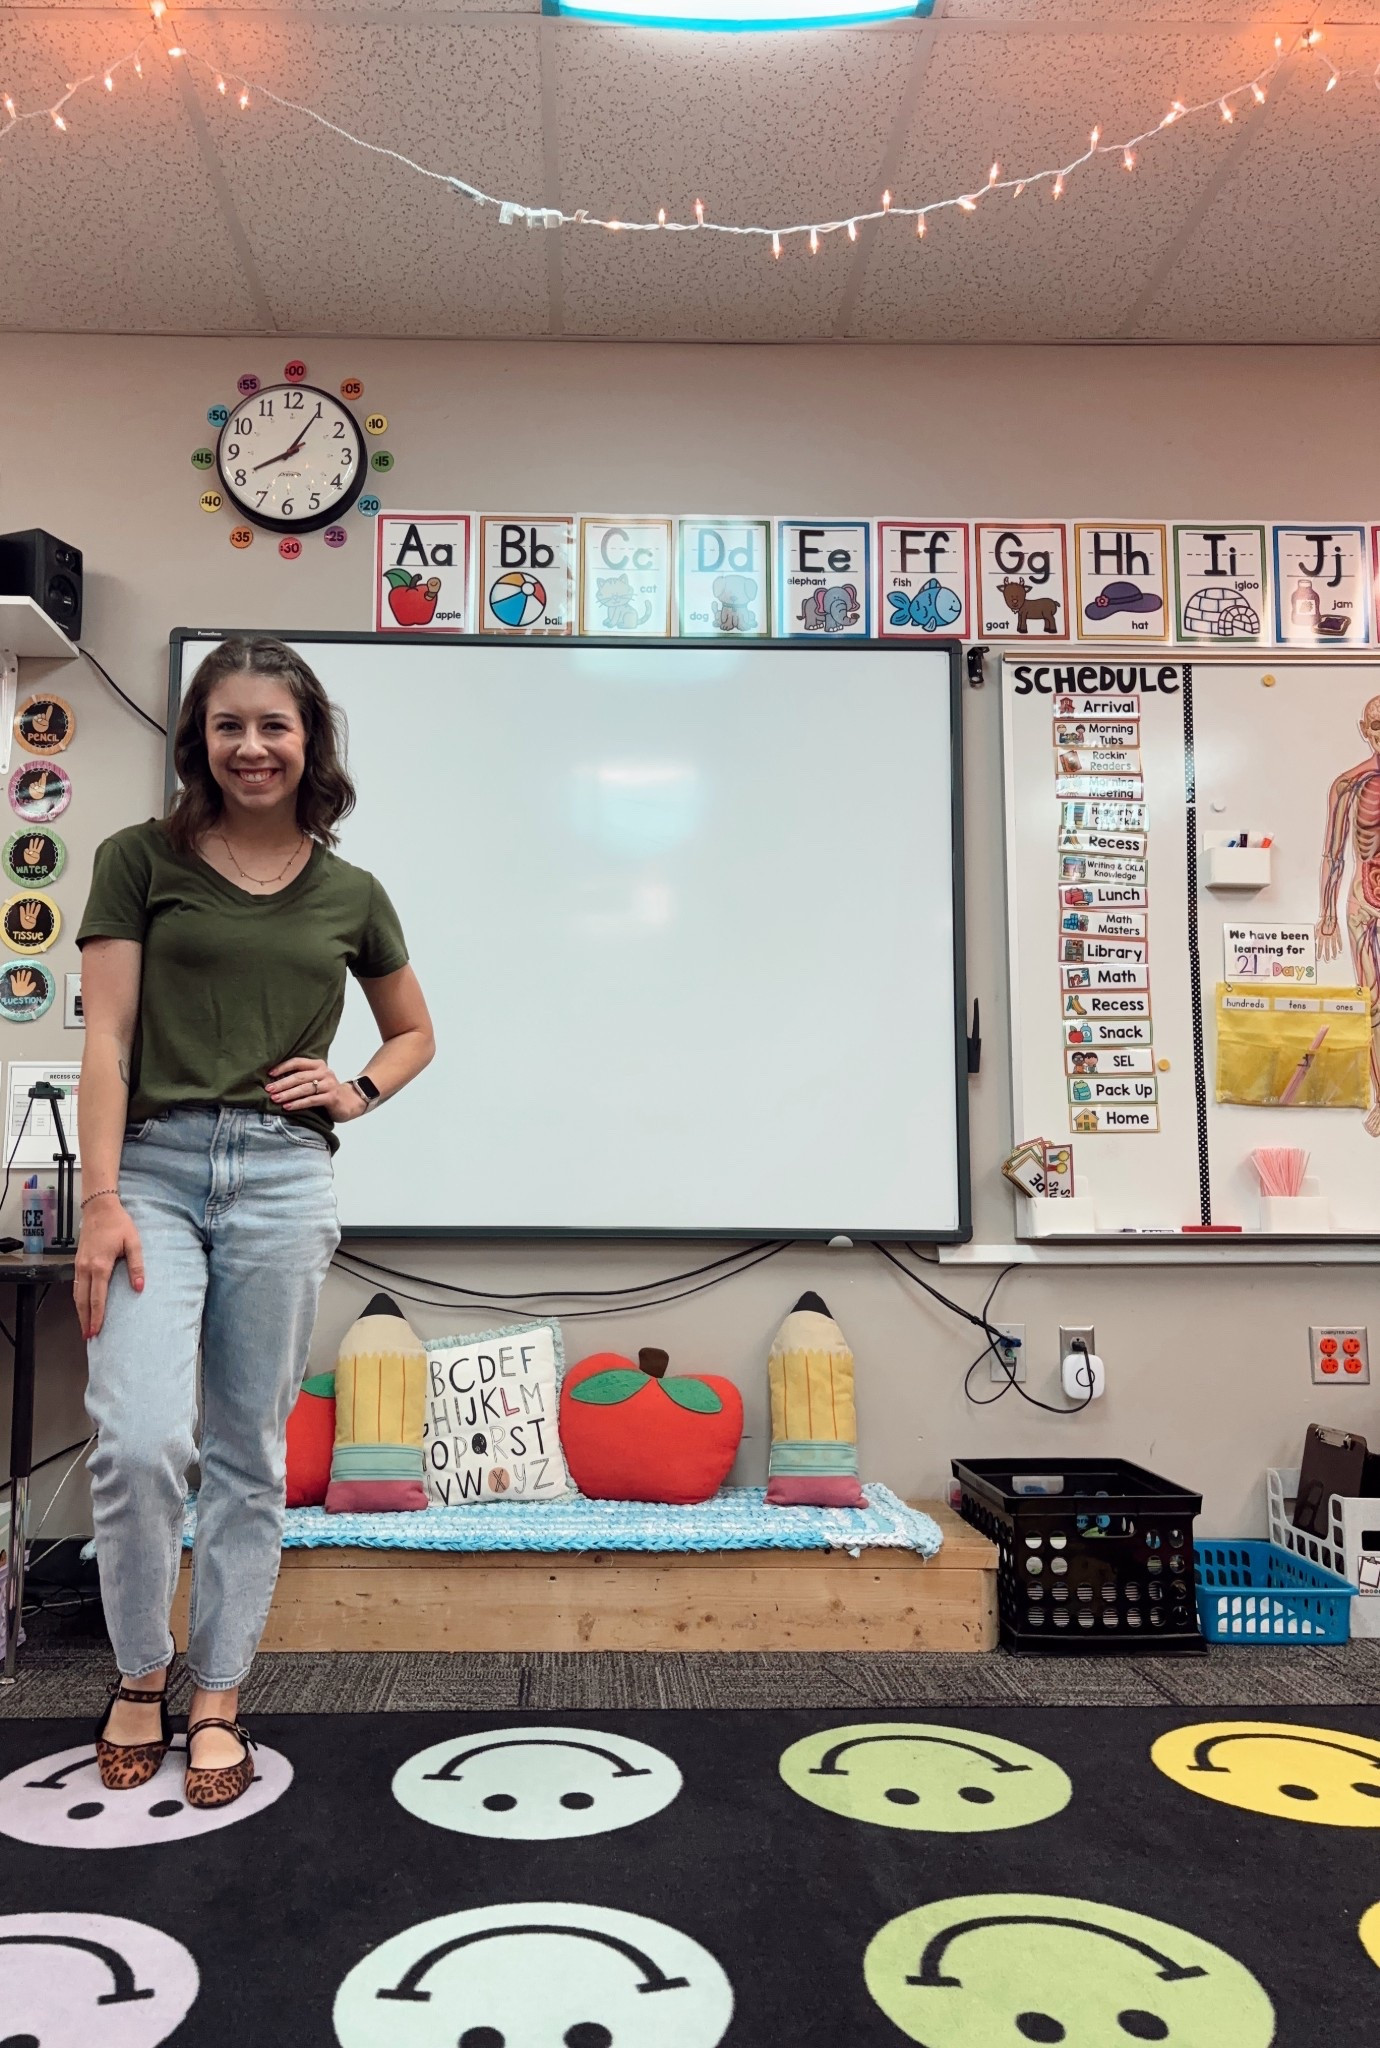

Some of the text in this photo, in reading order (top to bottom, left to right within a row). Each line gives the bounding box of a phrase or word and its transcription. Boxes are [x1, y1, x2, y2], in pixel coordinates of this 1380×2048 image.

[285, 366, 304, 376] :00
[240, 380, 257, 390] :55
[342, 384, 361, 394] :05
[284, 392, 304, 409] 12
[259, 400, 274, 417] 11
[315, 402, 323, 418] 1
[209, 410, 228, 421] :50
[234, 418, 252, 435] 10
[369, 419, 384, 429] :10
[333, 422, 345, 439] 2
[227, 444, 240, 460] 9
[341, 448, 353, 465] 3
[193, 453, 212, 464] :45
[375, 456, 389, 466] :15
[234, 469, 247, 486] 8
[330, 473, 343, 490] 4
[201, 497, 221, 507] :40
[256, 491, 268, 508] 7
[309, 493, 321, 510] 5
[281, 498, 295, 515] 6
[360, 501, 379, 511] :20
[232, 532, 250, 542] :35
[280, 544, 300, 554] :30
[396, 524, 453, 566] Aa
[501, 525, 554, 568] Bb
[601, 527, 654, 570] Cc
[699, 529, 754, 572] Dd
[799, 530, 851, 573] Ee
[900, 530, 950, 573] Ff
[1094, 532, 1150, 575] Hh
[1203, 534, 1237, 576] Ii
[995, 532, 1050, 584] Gg
[1299, 535, 1342, 587] Jj
[787, 577, 826, 587] elephant
[893, 577, 912, 587] fish
[1235, 581, 1259, 591] igloo
[640, 585, 657, 594] cat
[1332, 600, 1353, 610] jam
[436, 610, 461, 621] apple
[690, 611, 709, 623] dog
[986, 621, 1010, 631] goat
[1132, 621, 1149, 630] hat
[1084, 700, 1135, 713] Arrival
[1089, 724, 1134, 735] Morning
[1100, 736, 1124, 745] Tubs
[1090, 762, 1132, 771] Readers
[1089, 788, 1134, 799] Meeting
[1089, 835, 1140, 851] Recess
[1088, 861, 1145, 872] Writing & CKLA
[1094, 870, 1137, 881] Knowledge
[1098, 889, 1140, 902] Lunch
[1106, 915, 1133, 924] Math
[1098, 925, 1141, 936] Masters
[1230, 930, 1310, 941] We have been
[1088, 944, 1142, 962] Library
[1234, 944, 1306, 956] learning for
[1237, 954, 1258, 975] 21
[1098, 970, 1137, 983] Math
[1272, 962, 1315, 980] Days
[1092, 999, 1145, 1012] Recess
[1227, 998, 1265, 1009] hundreds
[1289, 1002, 1307, 1010] tens
[1336, 1004, 1354, 1012] ones
[1099, 1026, 1143, 1039] Snack
[1113, 1055, 1135, 1067] SEL
[1096, 1084, 1153, 1098] Pack Up
[1106, 1112, 1150, 1125] Home
